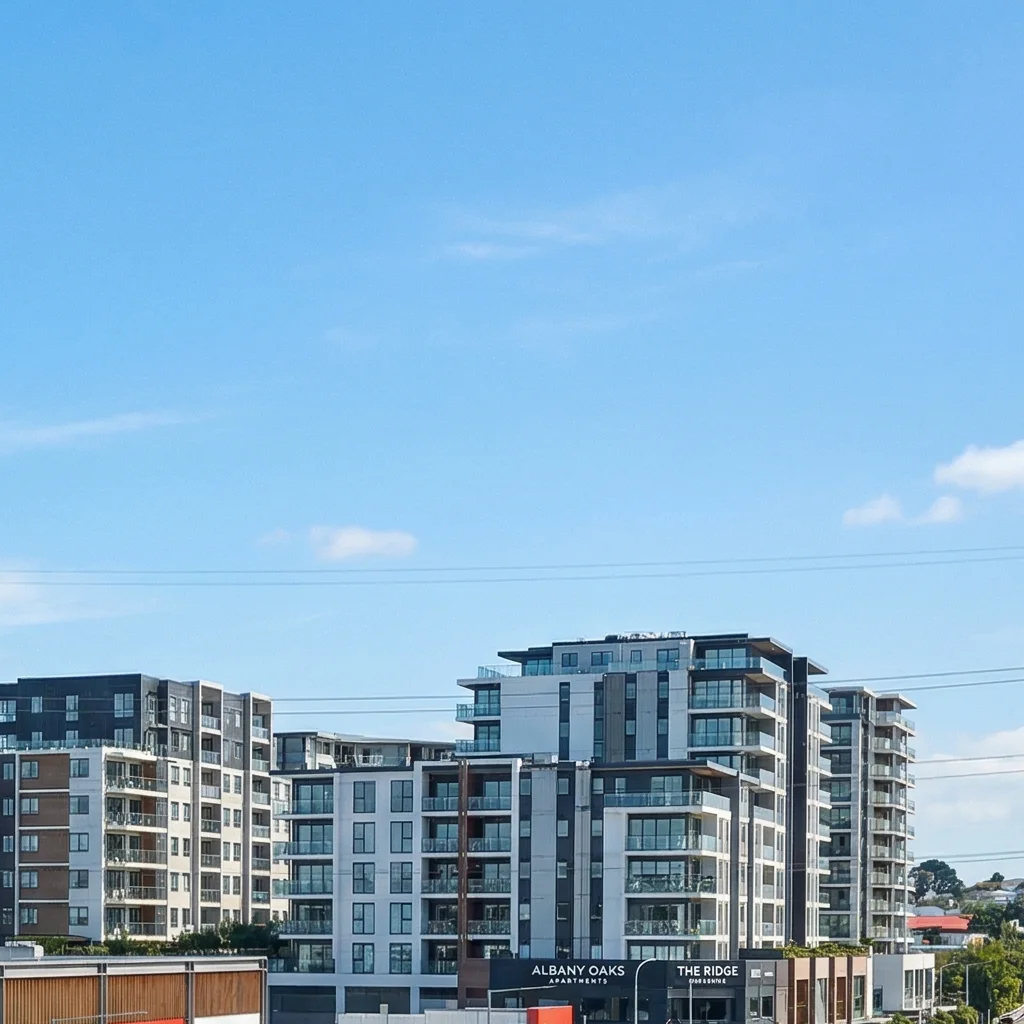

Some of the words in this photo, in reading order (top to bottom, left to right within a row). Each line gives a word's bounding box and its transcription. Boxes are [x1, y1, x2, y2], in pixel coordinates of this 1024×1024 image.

[531, 965, 586, 976] ALBANY
[588, 965, 625, 976] OAKS
[676, 966, 701, 976] THE
[703, 966, 739, 976] RIDGE
